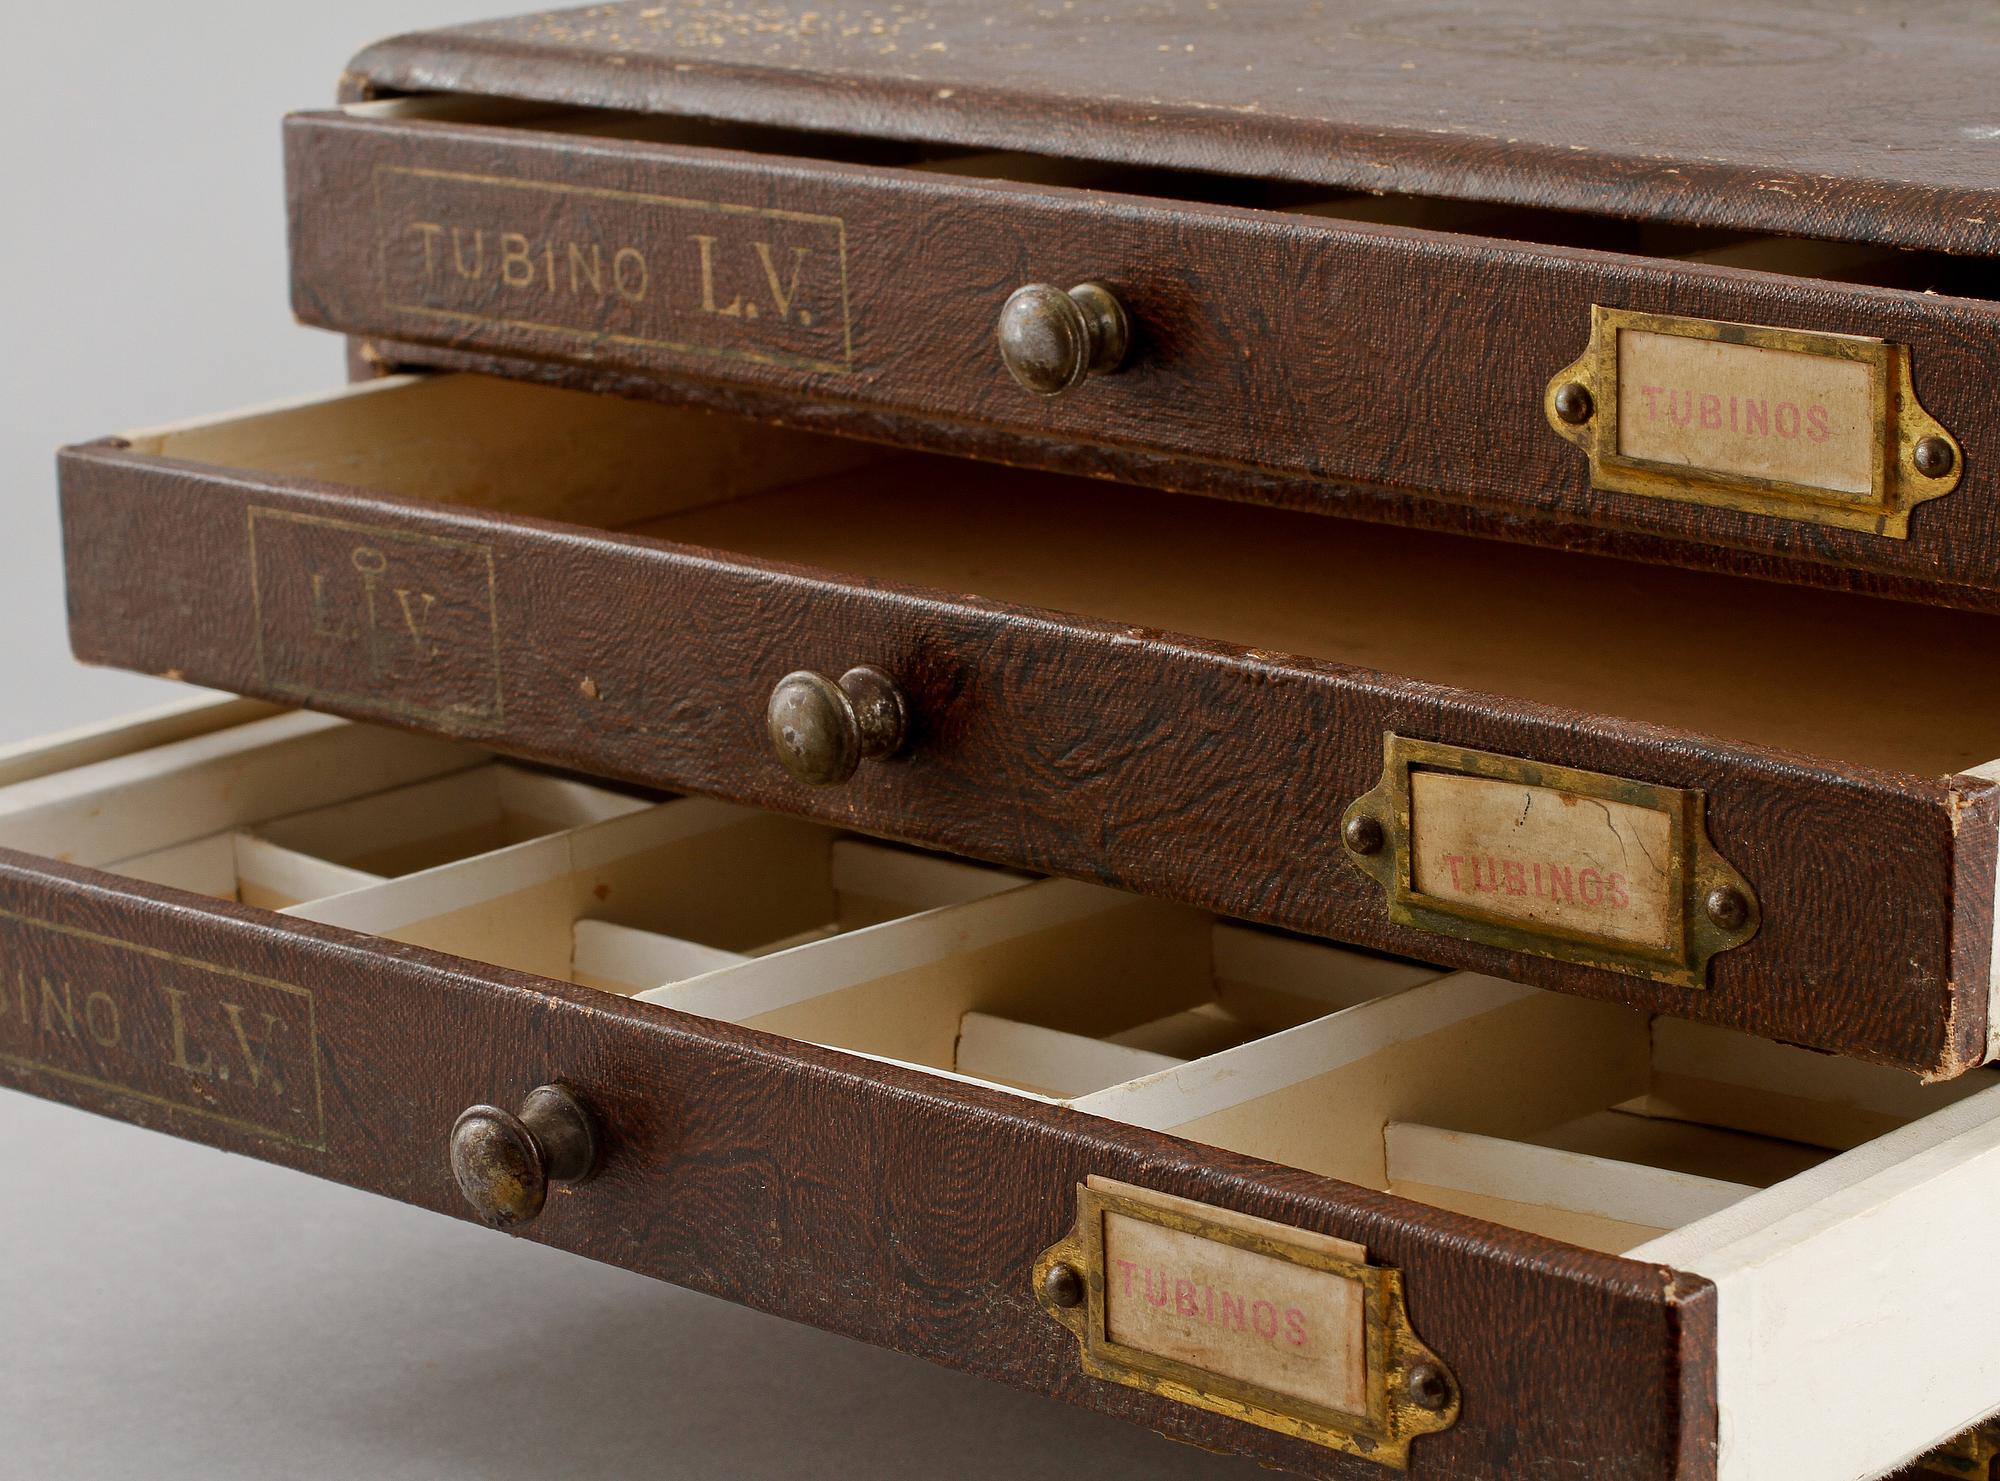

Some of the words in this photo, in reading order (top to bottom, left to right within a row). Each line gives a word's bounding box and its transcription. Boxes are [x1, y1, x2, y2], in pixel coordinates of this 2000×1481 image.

[410, 221, 649, 302] TUBINO
[688, 233, 813, 327] L.V.
[1641, 384, 1831, 444] TUBINOS
[1442, 853, 1630, 910] TUBINOS
[0, 968, 121, 1047] INO
[163, 985, 285, 1096] L.V.
[1116, 1258, 1309, 1347] TUBINOS
